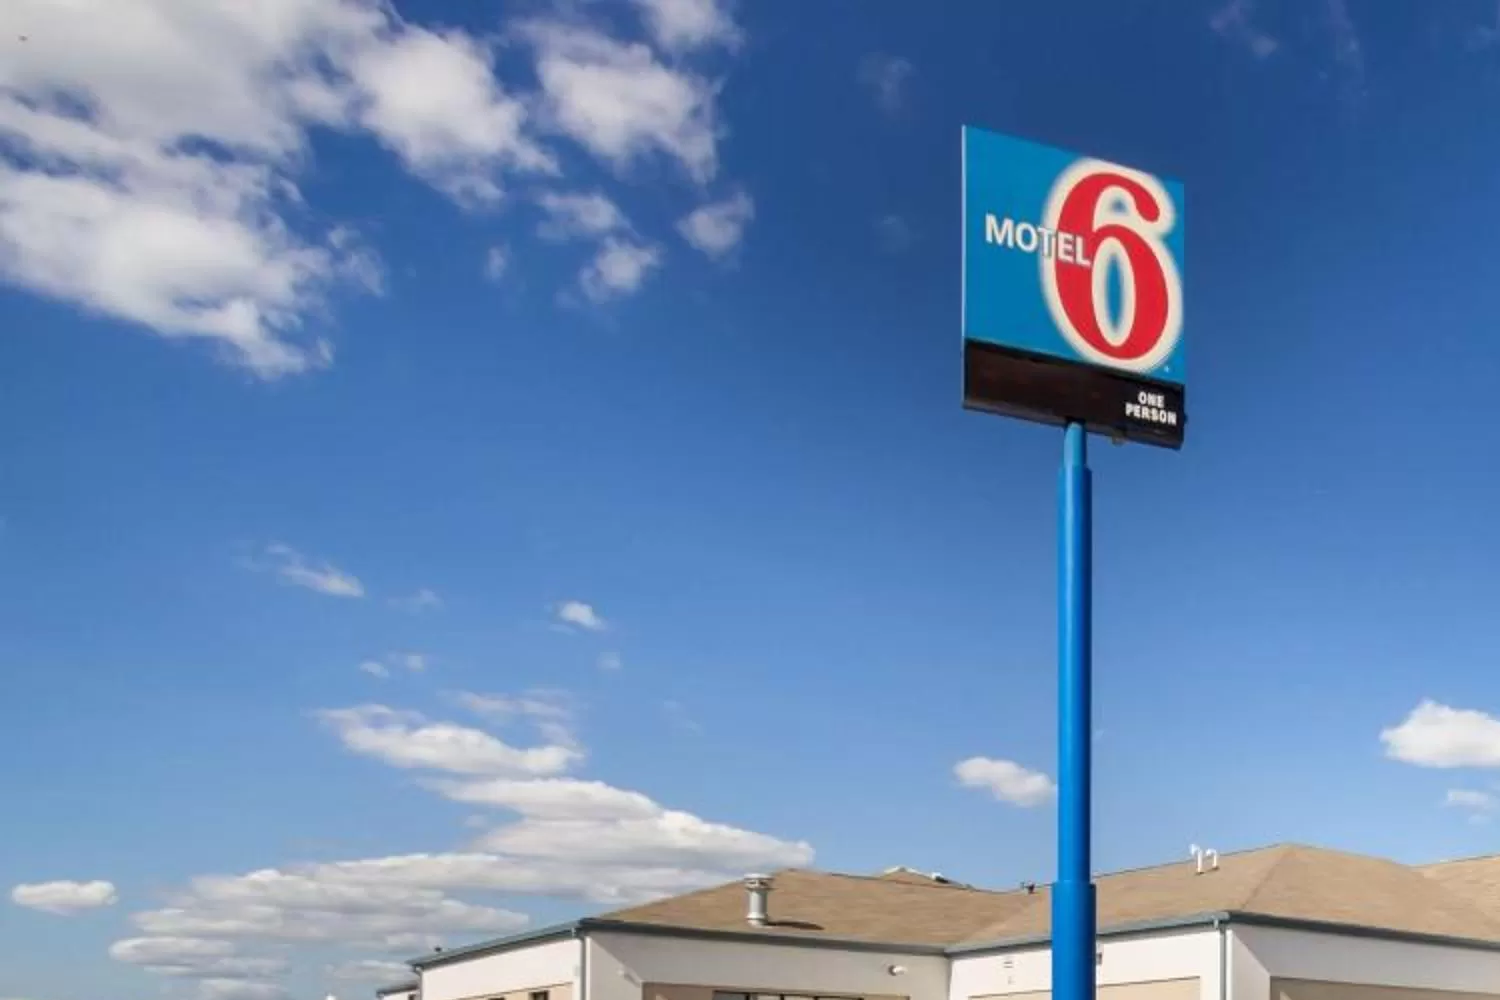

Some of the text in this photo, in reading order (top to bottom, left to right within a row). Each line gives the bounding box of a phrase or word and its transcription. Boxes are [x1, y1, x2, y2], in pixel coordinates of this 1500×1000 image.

[985, 157, 1182, 373] MOTEL 6
[1138, 391, 1165, 408] ONE
[1125, 402, 1177, 426] PERSON
